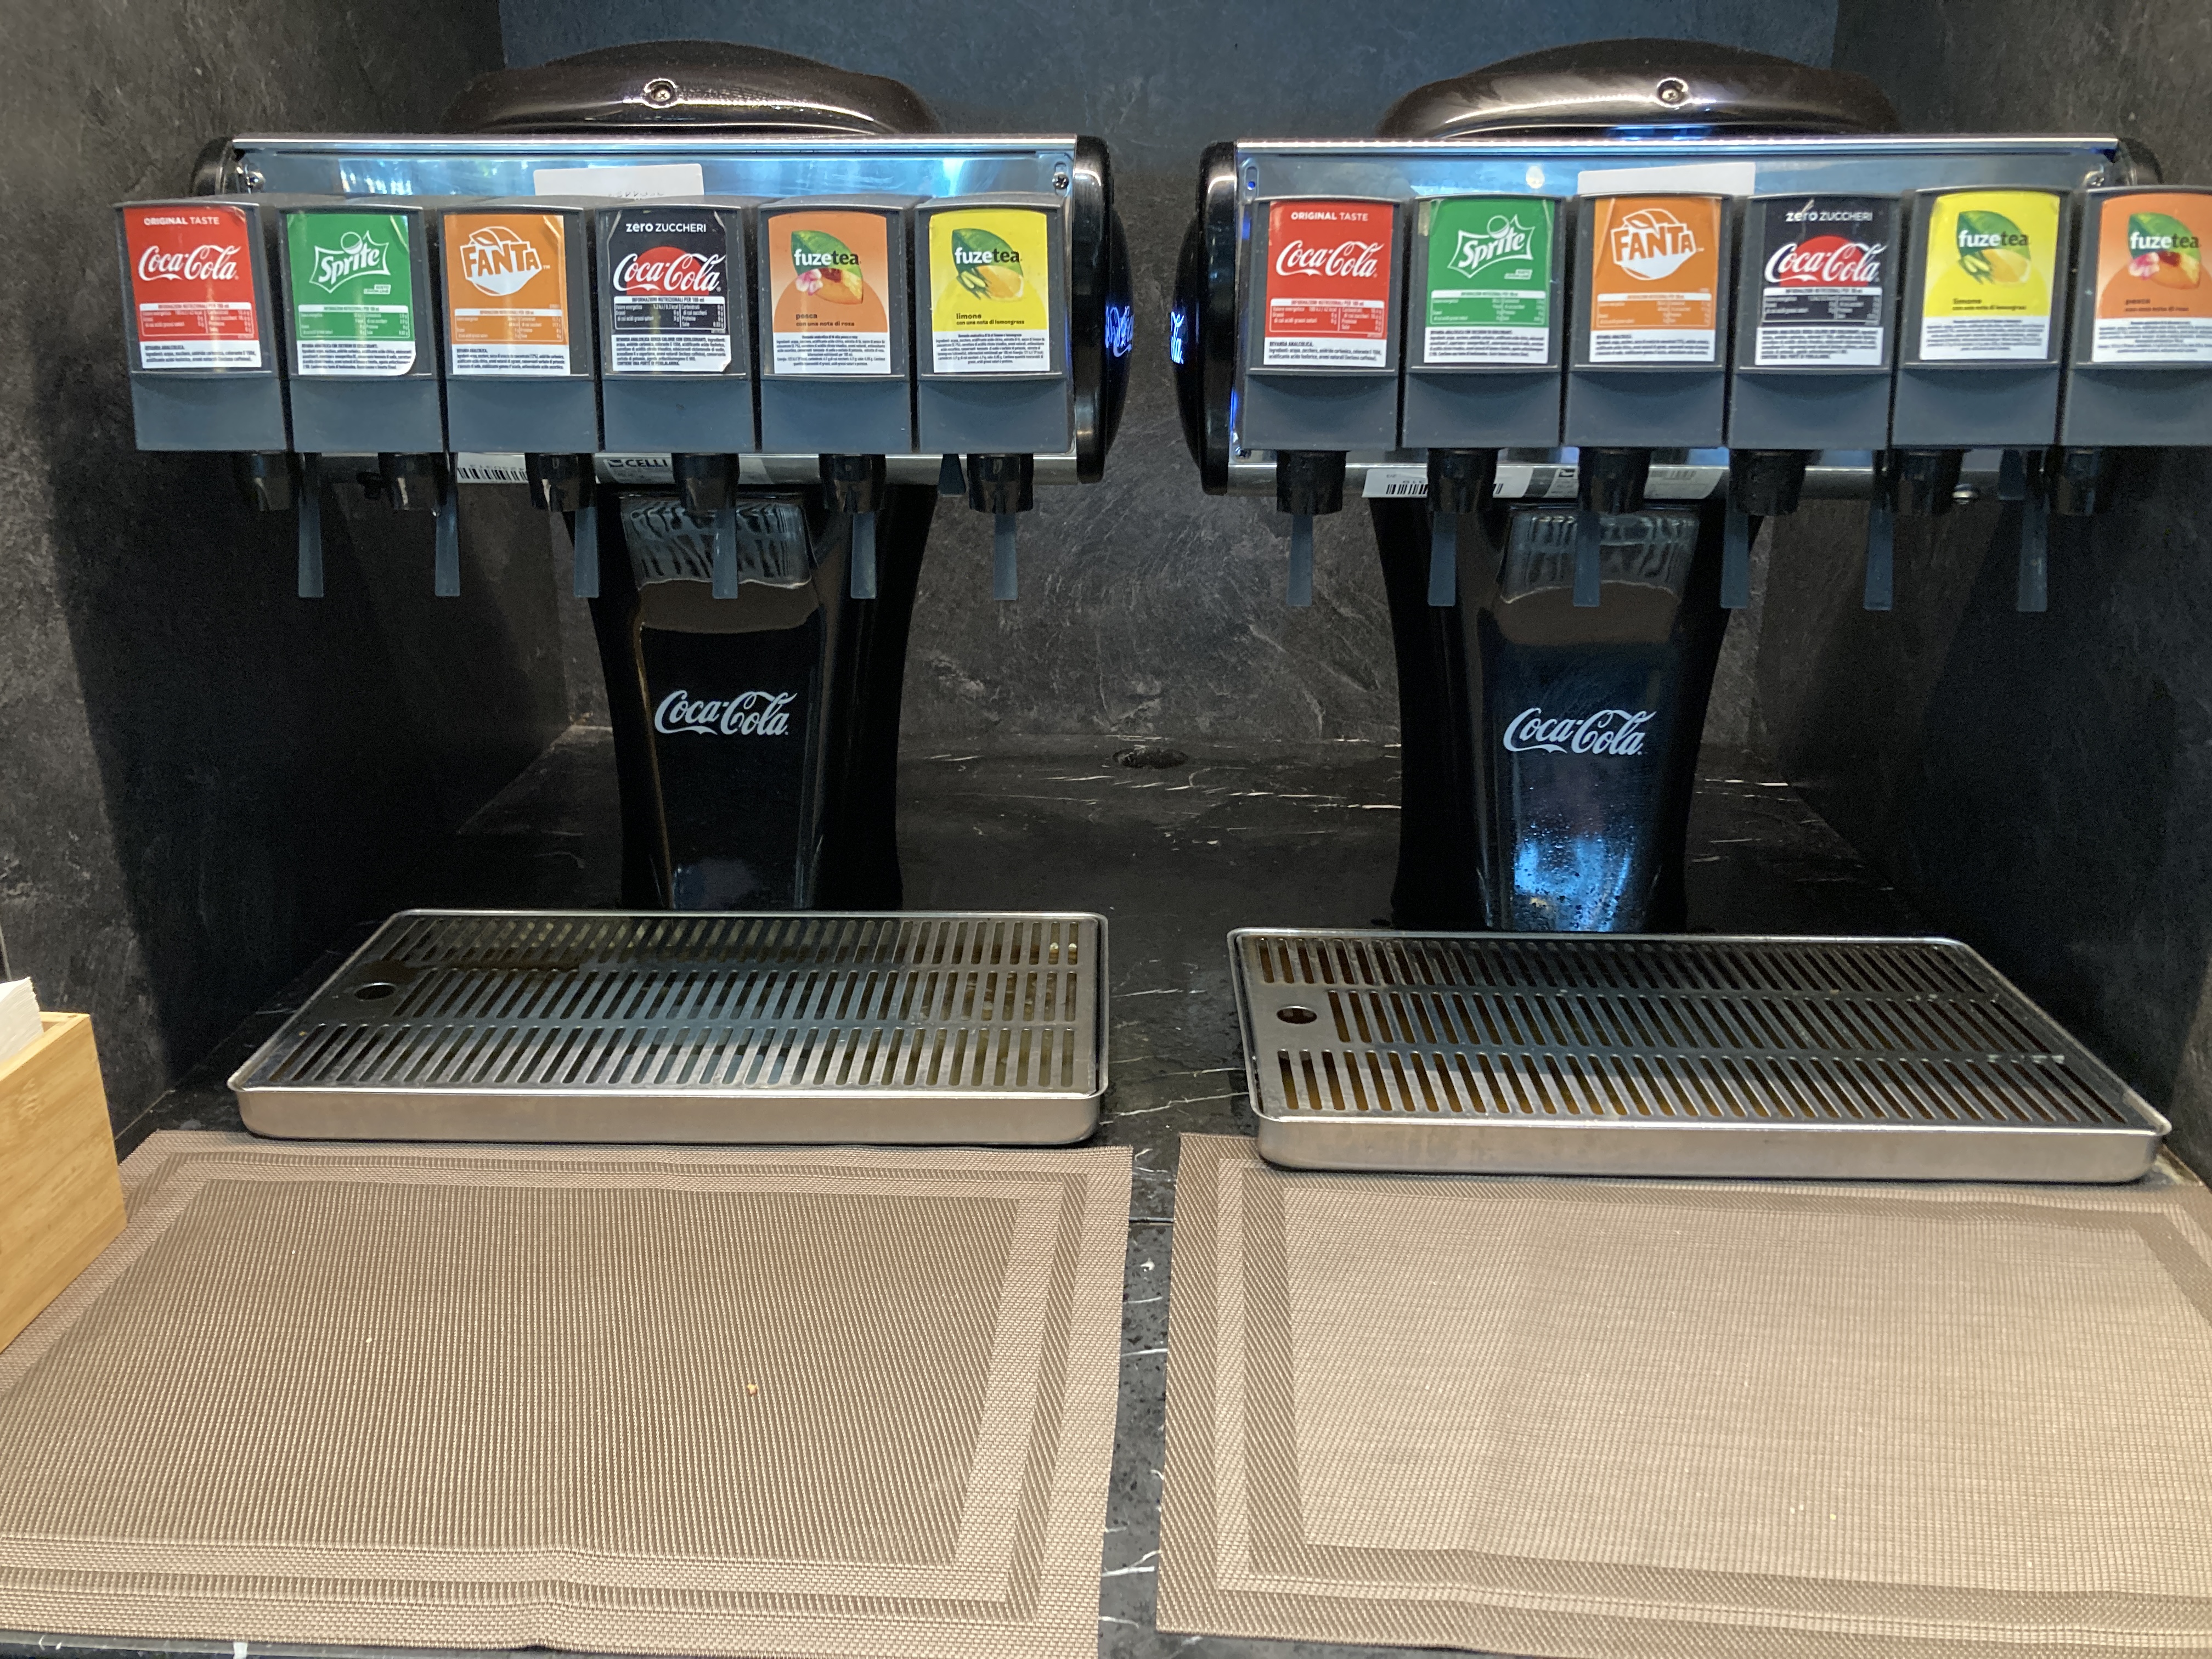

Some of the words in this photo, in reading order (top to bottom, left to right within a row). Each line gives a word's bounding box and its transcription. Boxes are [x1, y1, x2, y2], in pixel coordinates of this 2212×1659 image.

[144, 217, 188, 225] ORIGINAL
[189, 216, 220, 225] TASTE
[626, 223, 653, 233] zero
[655, 223, 707, 233] ZUCCHERI
[1291, 211, 1337, 221] ORIGINAL
[1340, 212, 1368, 221] TASTE
[1786, 211, 1817, 222] zero
[1819, 211, 1873, 222] ZUCCHERI
[318, 239, 380, 284] Sprite
[461, 241, 540, 277] FANTA
[1276, 240, 1384, 278] Coca-Cola
[1458, 226, 1525, 269] Sprite
[1612, 223, 1695, 263] FANTA
[138, 244, 241, 281] Coca-Cola
[613, 253, 726, 292] Coca-Cola
[1764, 241, 1887, 284] Coca-Cola
[625, 459, 668, 468] CELLI
[654, 690, 798, 736] Coca-Cola
[1503, 707, 1657, 755] Coca-Cola
